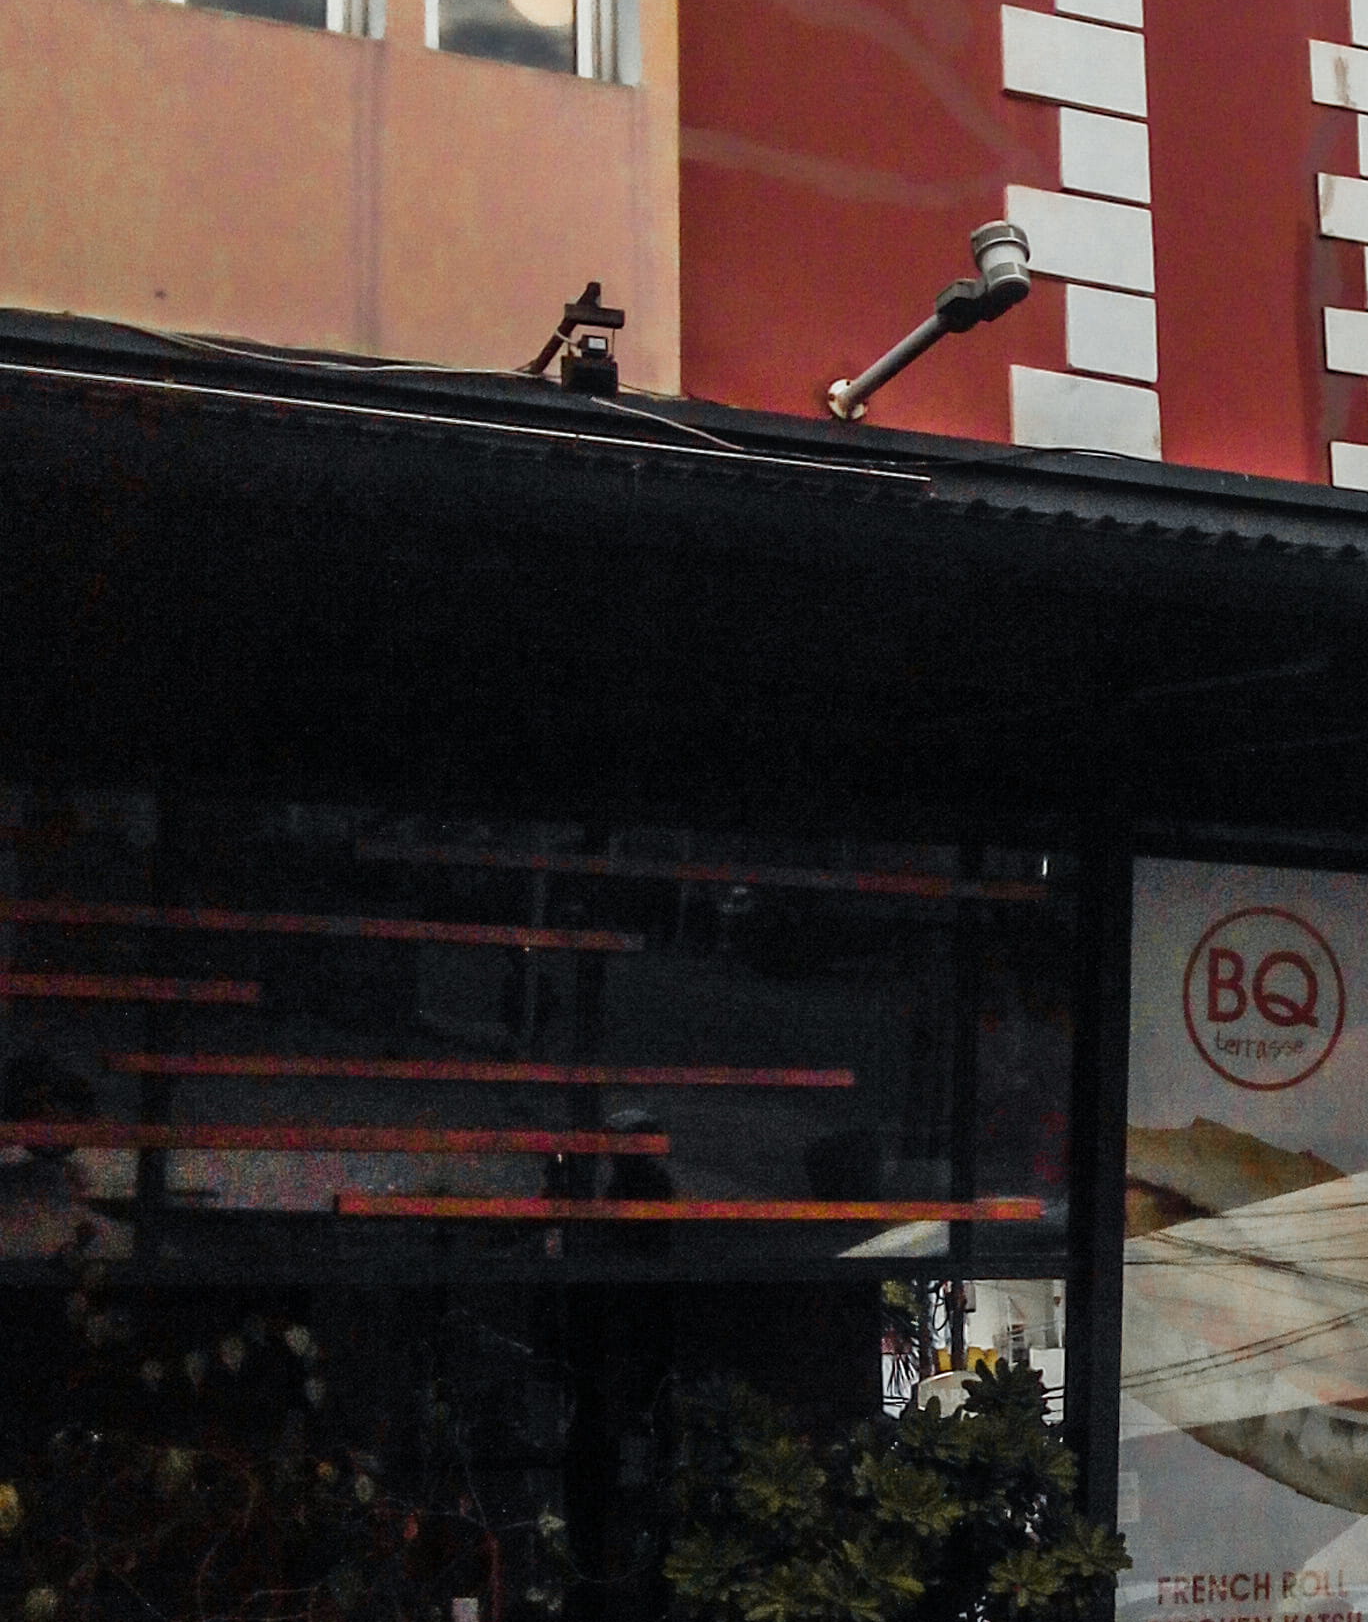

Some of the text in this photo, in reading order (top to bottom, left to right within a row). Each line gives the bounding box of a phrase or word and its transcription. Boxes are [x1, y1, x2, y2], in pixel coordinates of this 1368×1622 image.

[1207, 947, 1319, 1028] BQ
[1157, 1568, 1348, 1605] FRENCH ROLL
